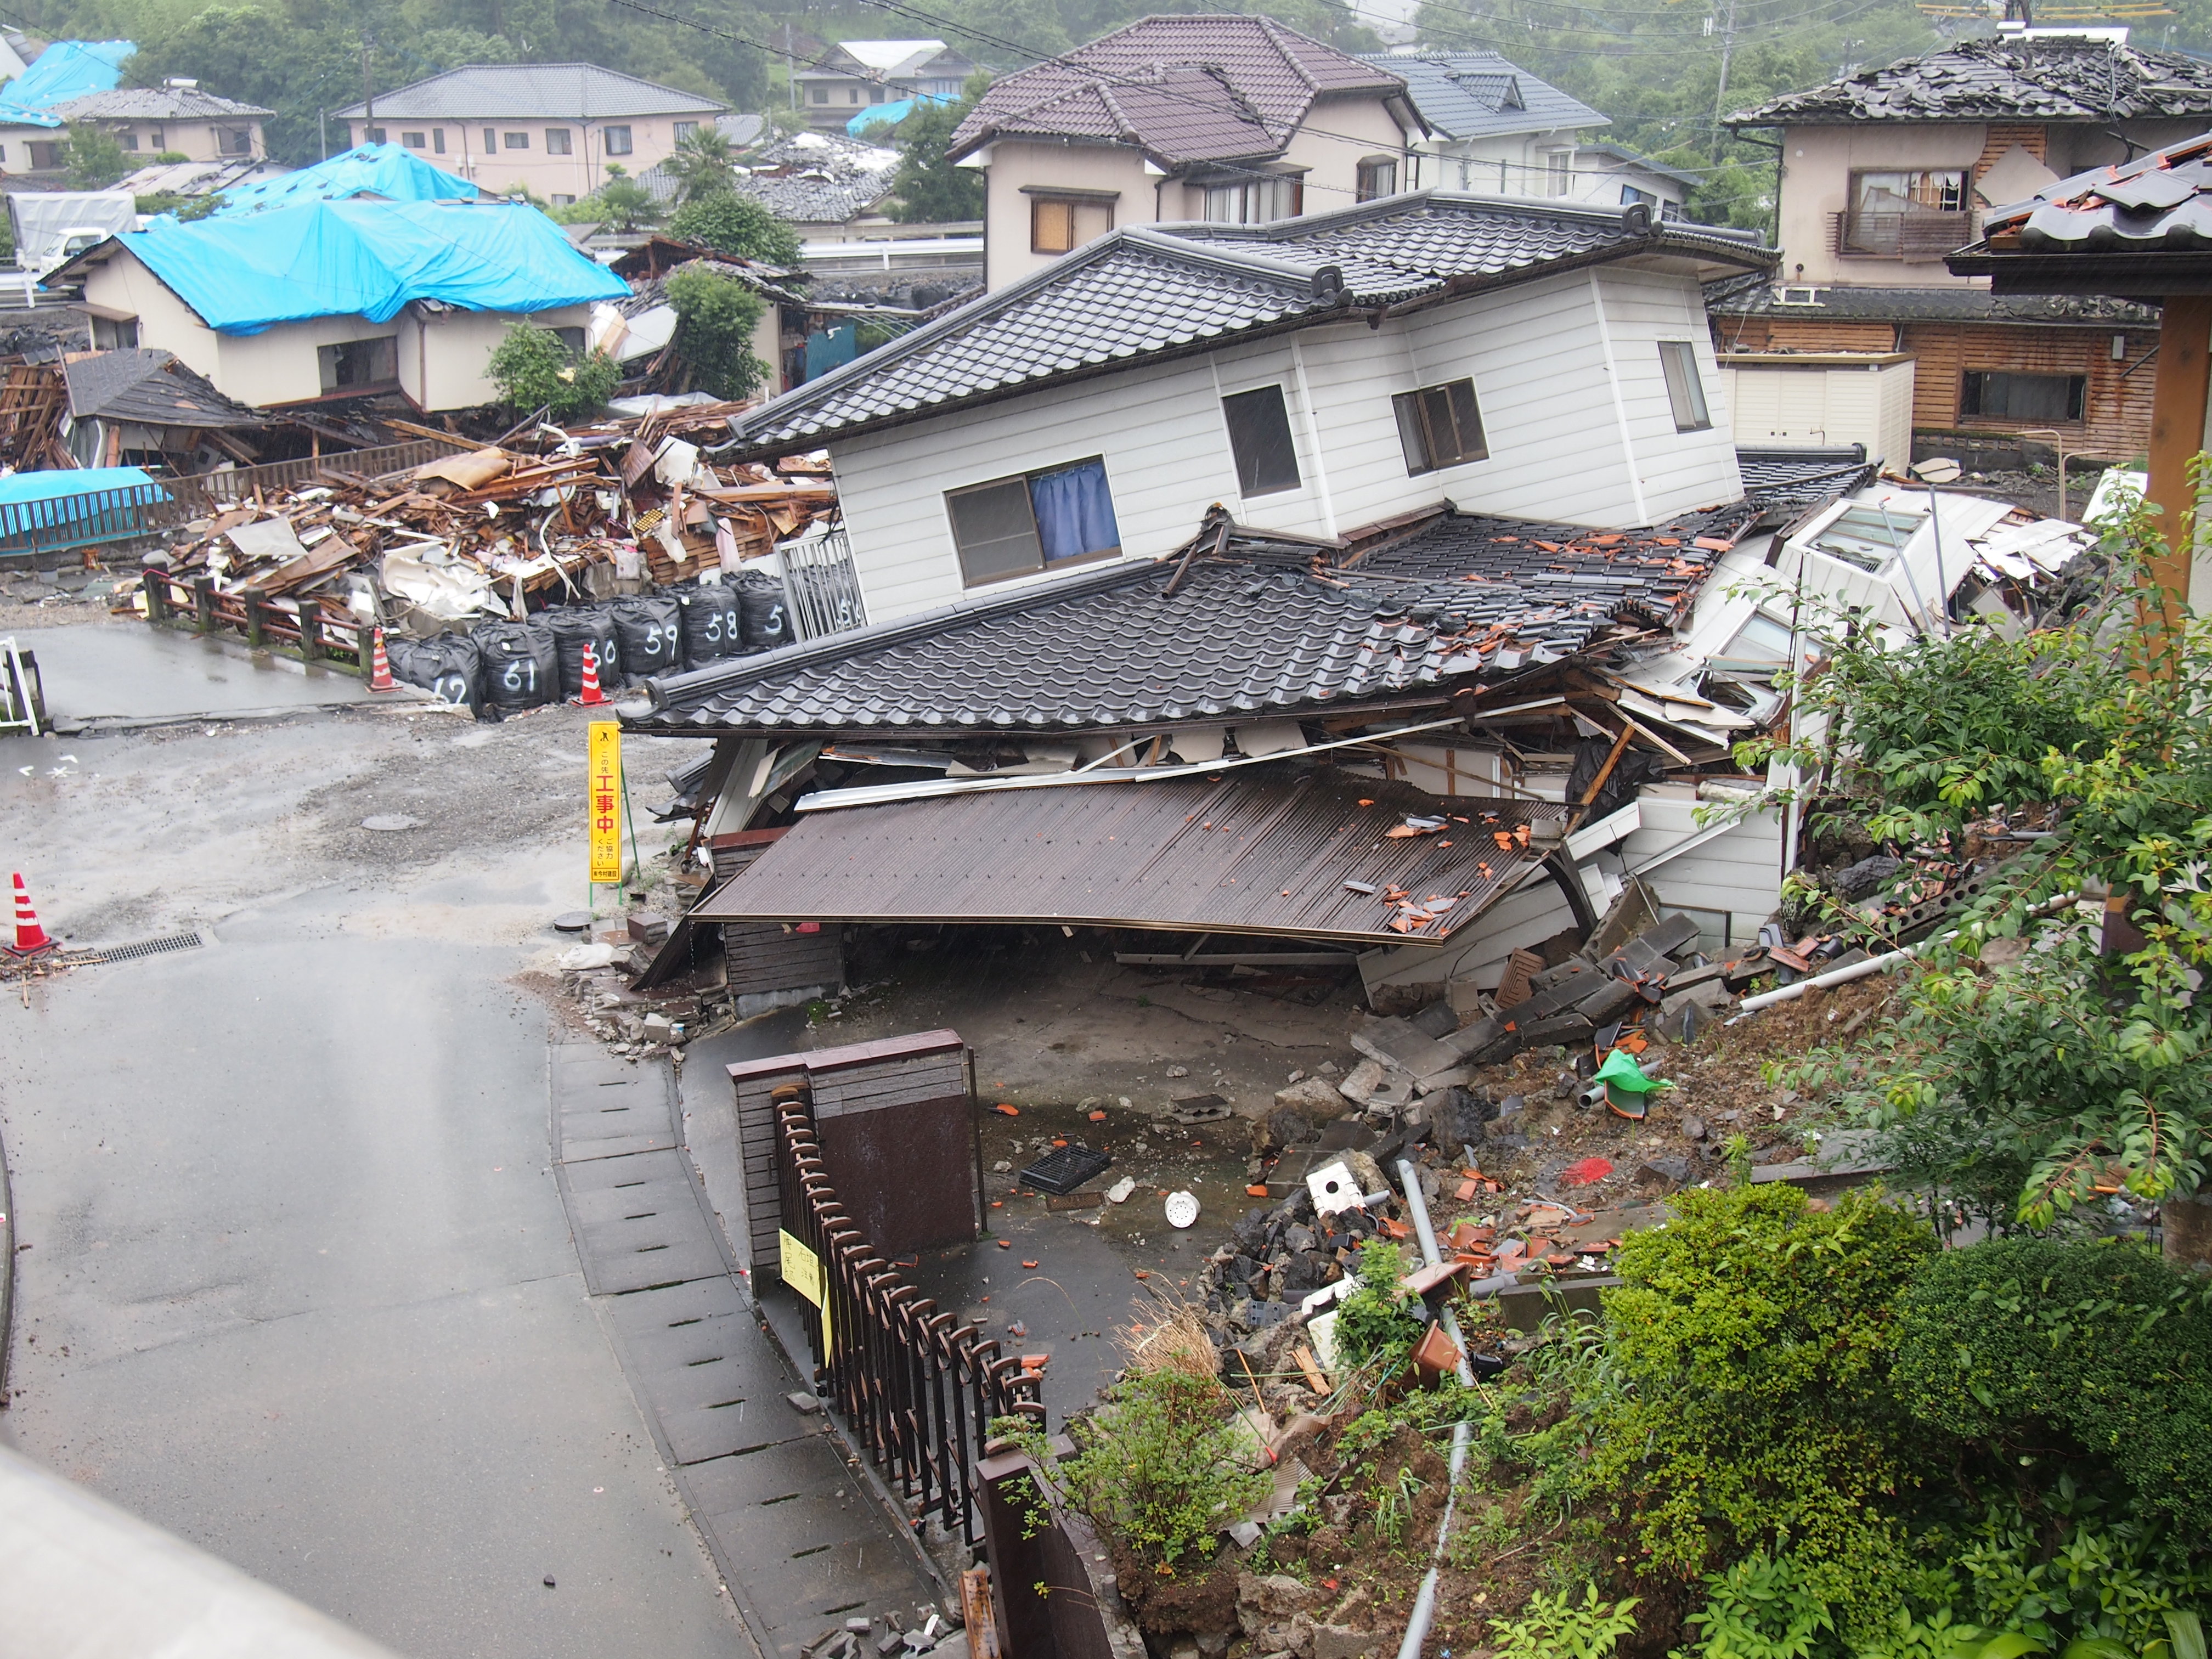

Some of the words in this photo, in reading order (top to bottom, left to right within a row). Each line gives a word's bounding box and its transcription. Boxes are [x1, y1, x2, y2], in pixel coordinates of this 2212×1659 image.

[644, 624, 678, 661] 59
[706, 611, 738, 641] 58
[504, 659, 535, 692] 61
[596, 775, 614, 834] 工事中
